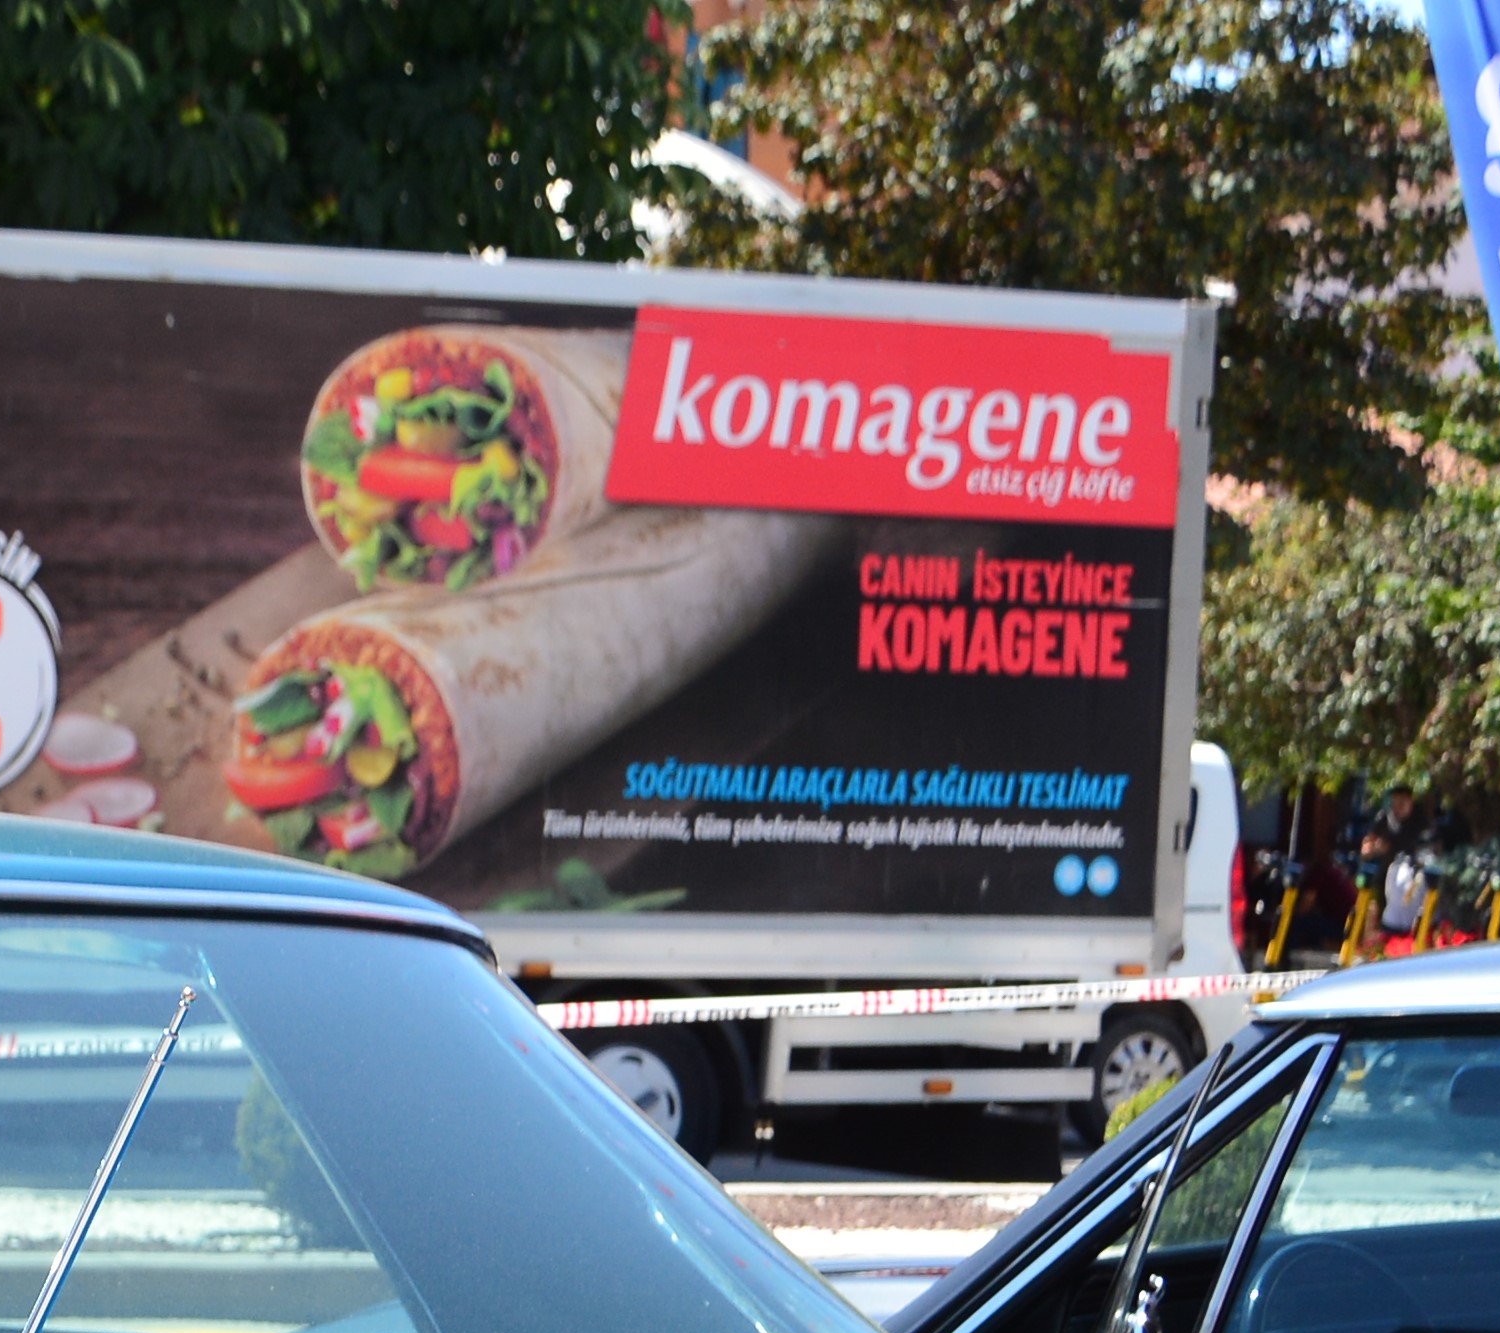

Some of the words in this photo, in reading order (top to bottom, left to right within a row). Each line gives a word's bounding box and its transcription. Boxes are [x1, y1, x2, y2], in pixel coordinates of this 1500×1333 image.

[653, 337, 1131, 490] komagene
[966, 465, 1023, 496] etsiz
[1026, 465, 1066, 507] çiğ
[1068, 466, 1134, 506] köfte
[859, 553, 960, 600] CANIN
[973, 547, 1134, 605] İSTEYİNCE
[858, 602, 1131, 678] KOMAGENE
[622, 756, 770, 801] SOĞUTMALI
[768, 765, 908, 811] ARAÇLARLA
[910, 763, 1017, 808] SAĞLIKLI
[1018, 766, 1129, 810] TESLİMAT
